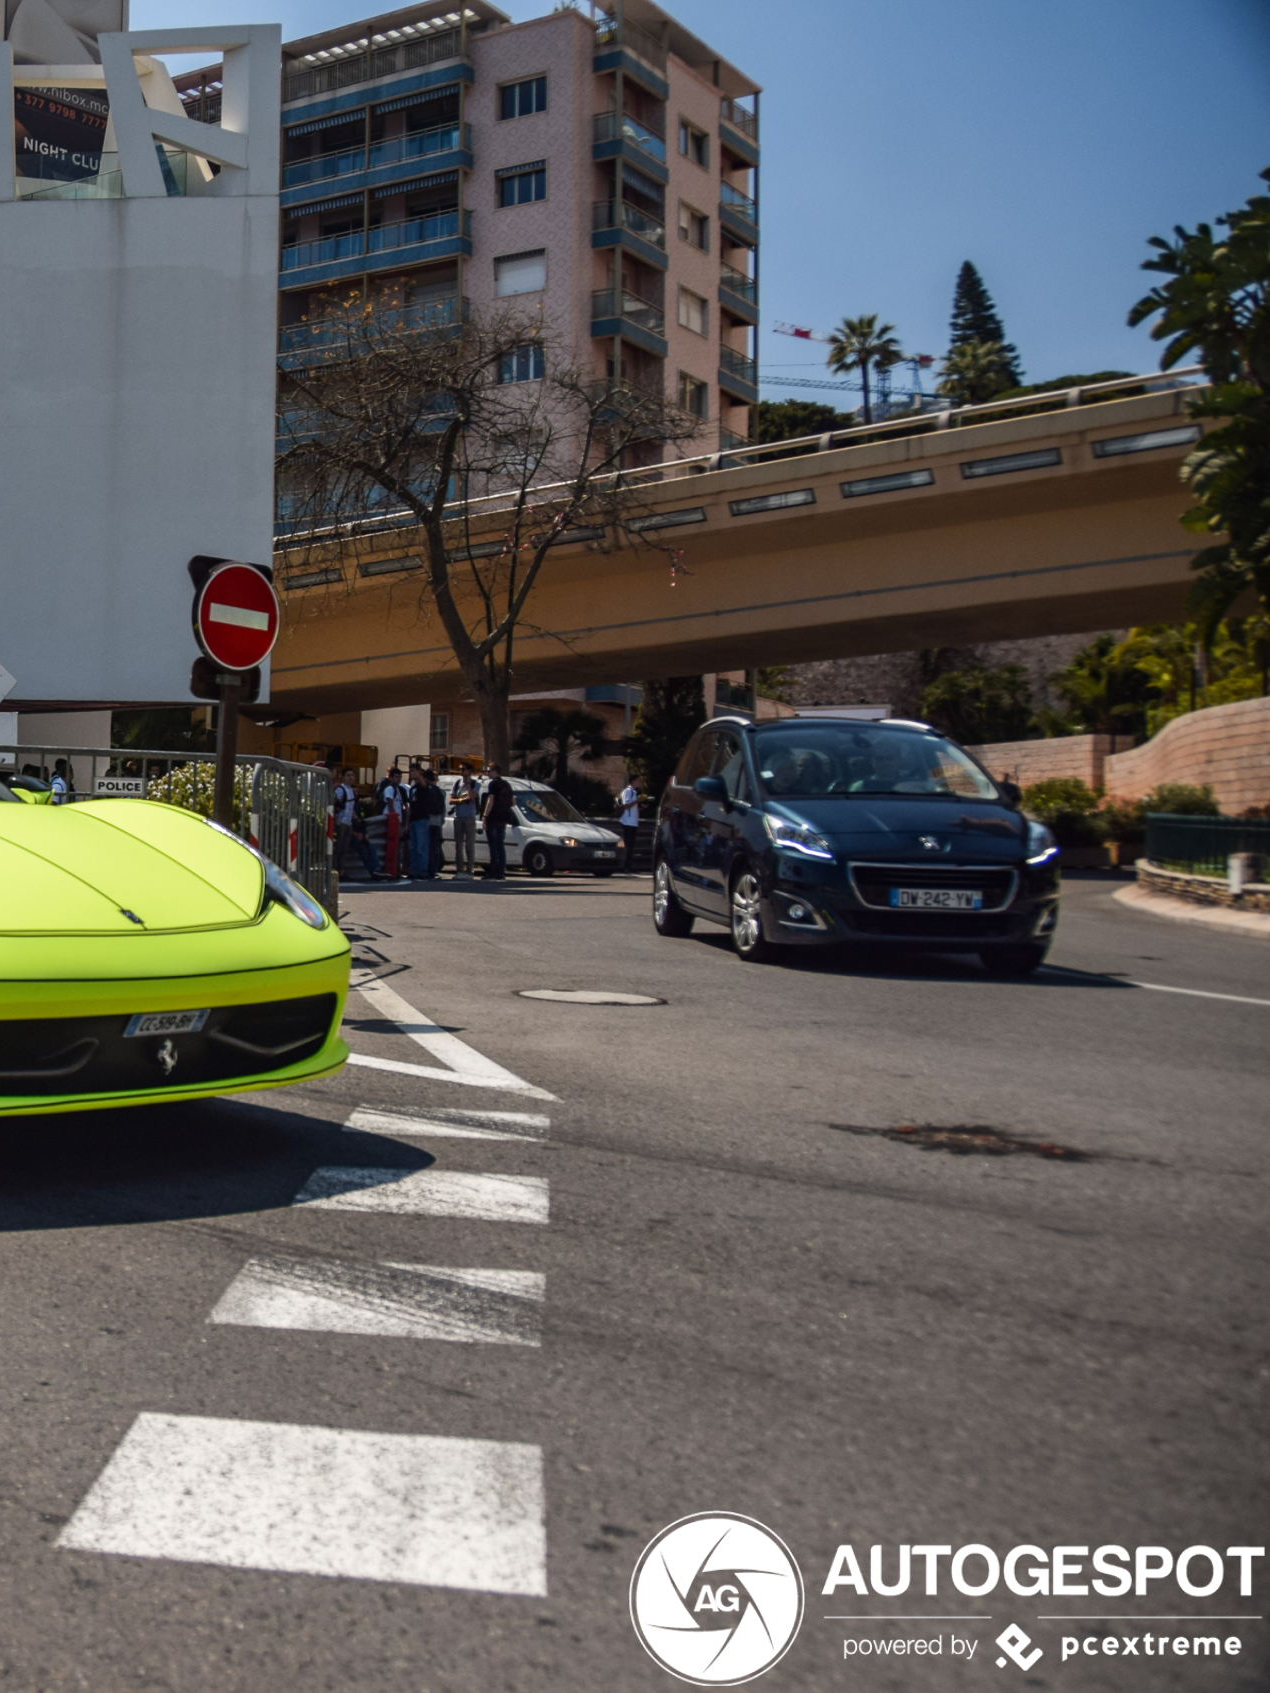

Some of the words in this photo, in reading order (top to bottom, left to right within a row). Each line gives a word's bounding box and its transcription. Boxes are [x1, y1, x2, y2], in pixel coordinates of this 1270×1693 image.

[25, 94, 45, 109] 377
[49, 102, 76, 120] 9798
[81, 113, 107, 130] 7777
[23, 136, 68, 161] NIGHT
[97, 781, 141, 792] POLICE
